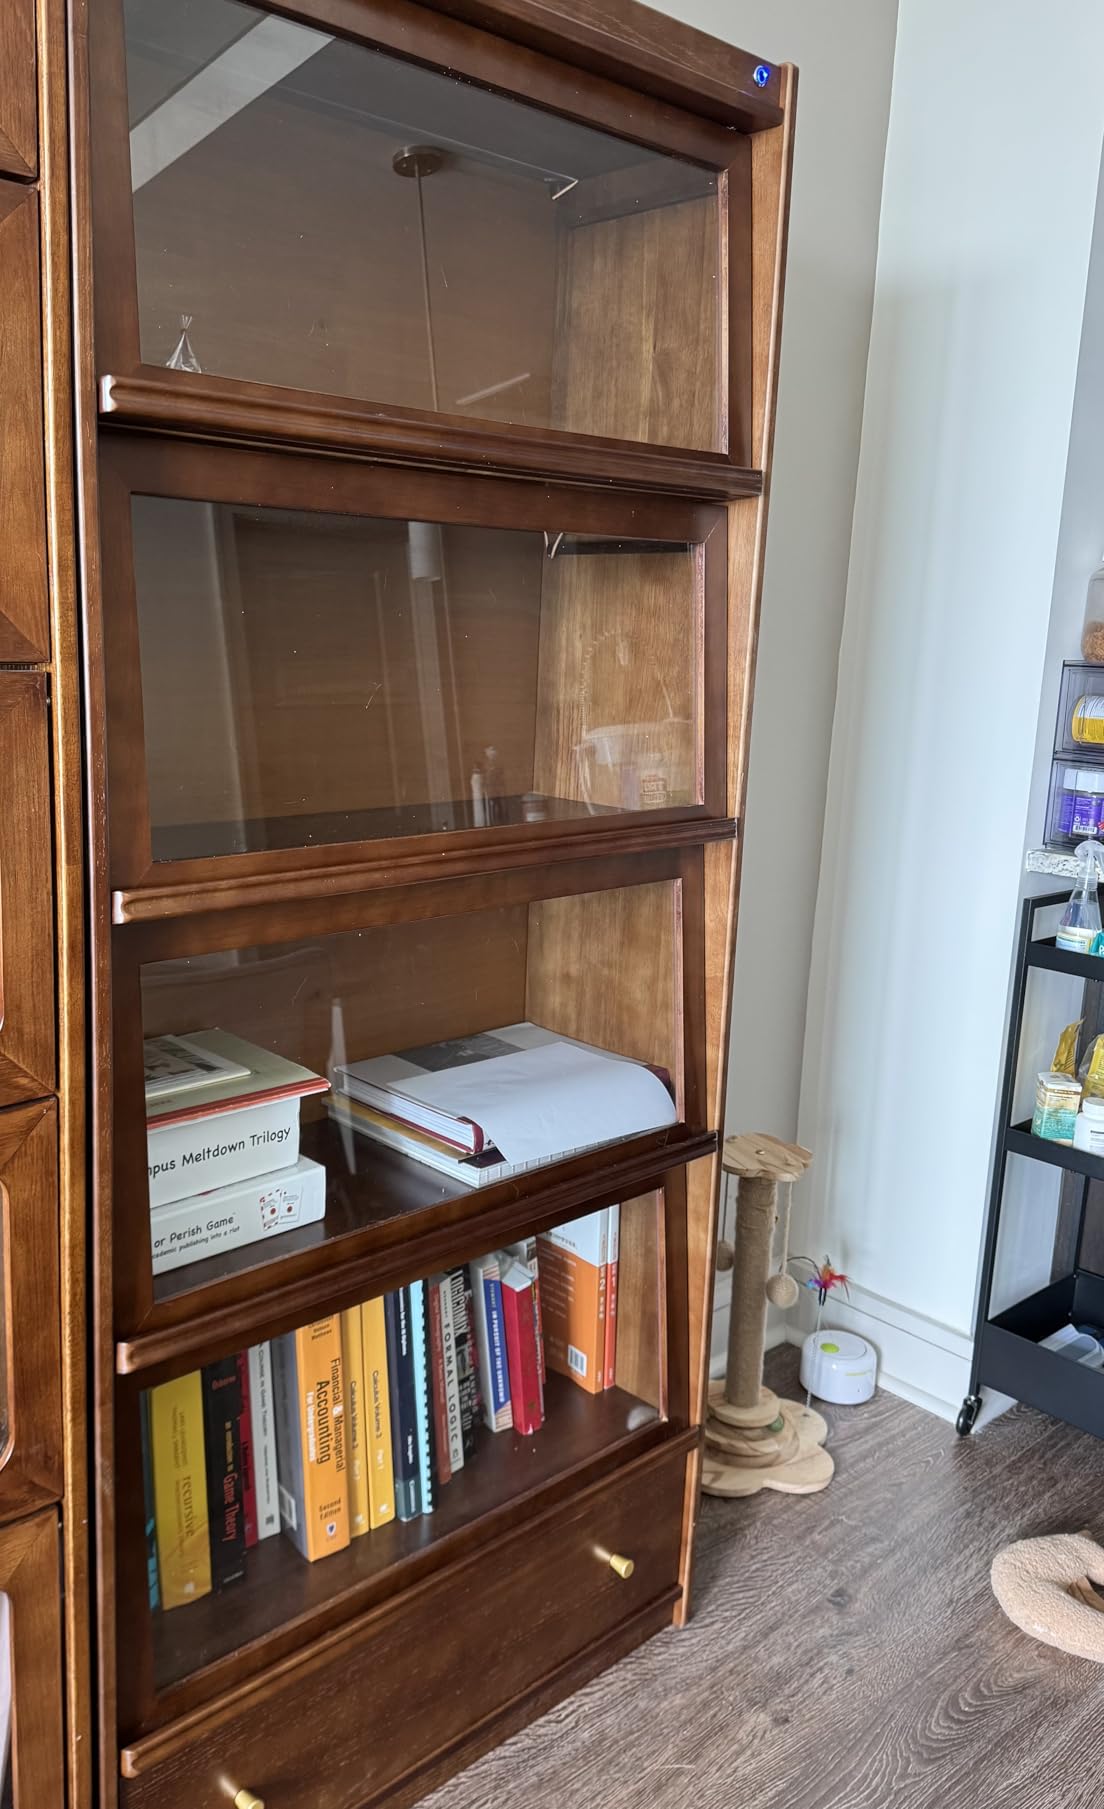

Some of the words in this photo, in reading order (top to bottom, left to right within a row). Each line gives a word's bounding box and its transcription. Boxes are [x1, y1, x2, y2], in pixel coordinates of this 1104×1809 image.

[181, 1140, 246, 1167] Meltdown
[250, 1126, 291, 1147] Trilogy
[154, 1237, 166, 1248] or
[170, 1225, 202, 1243] Perish
[206, 1216, 234, 1231] Game
[179, 1236, 209, 1252] publishing
[210, 1232, 222, 1241] into
[450, 1270, 470, 1338] LOGICOMIX
[492, 1319, 501, 1347] PURSUIT
[444, 1322, 455, 1387] FORMAL
[330, 1358, 343, 1406] Financial
[496, 1370, 505, 1403] UNKNOWN
[316, 1380, 332, 1465] Accounting
[332, 1405, 343, 1415] &
[448, 1396, 458, 1443] LOGIC
[333, 1414, 346, 1473] Managerial
[182, 1475, 195, 1538] recursive
[223, 1472, 238, 1504] Game
[222, 1503, 240, 1542] Theory
